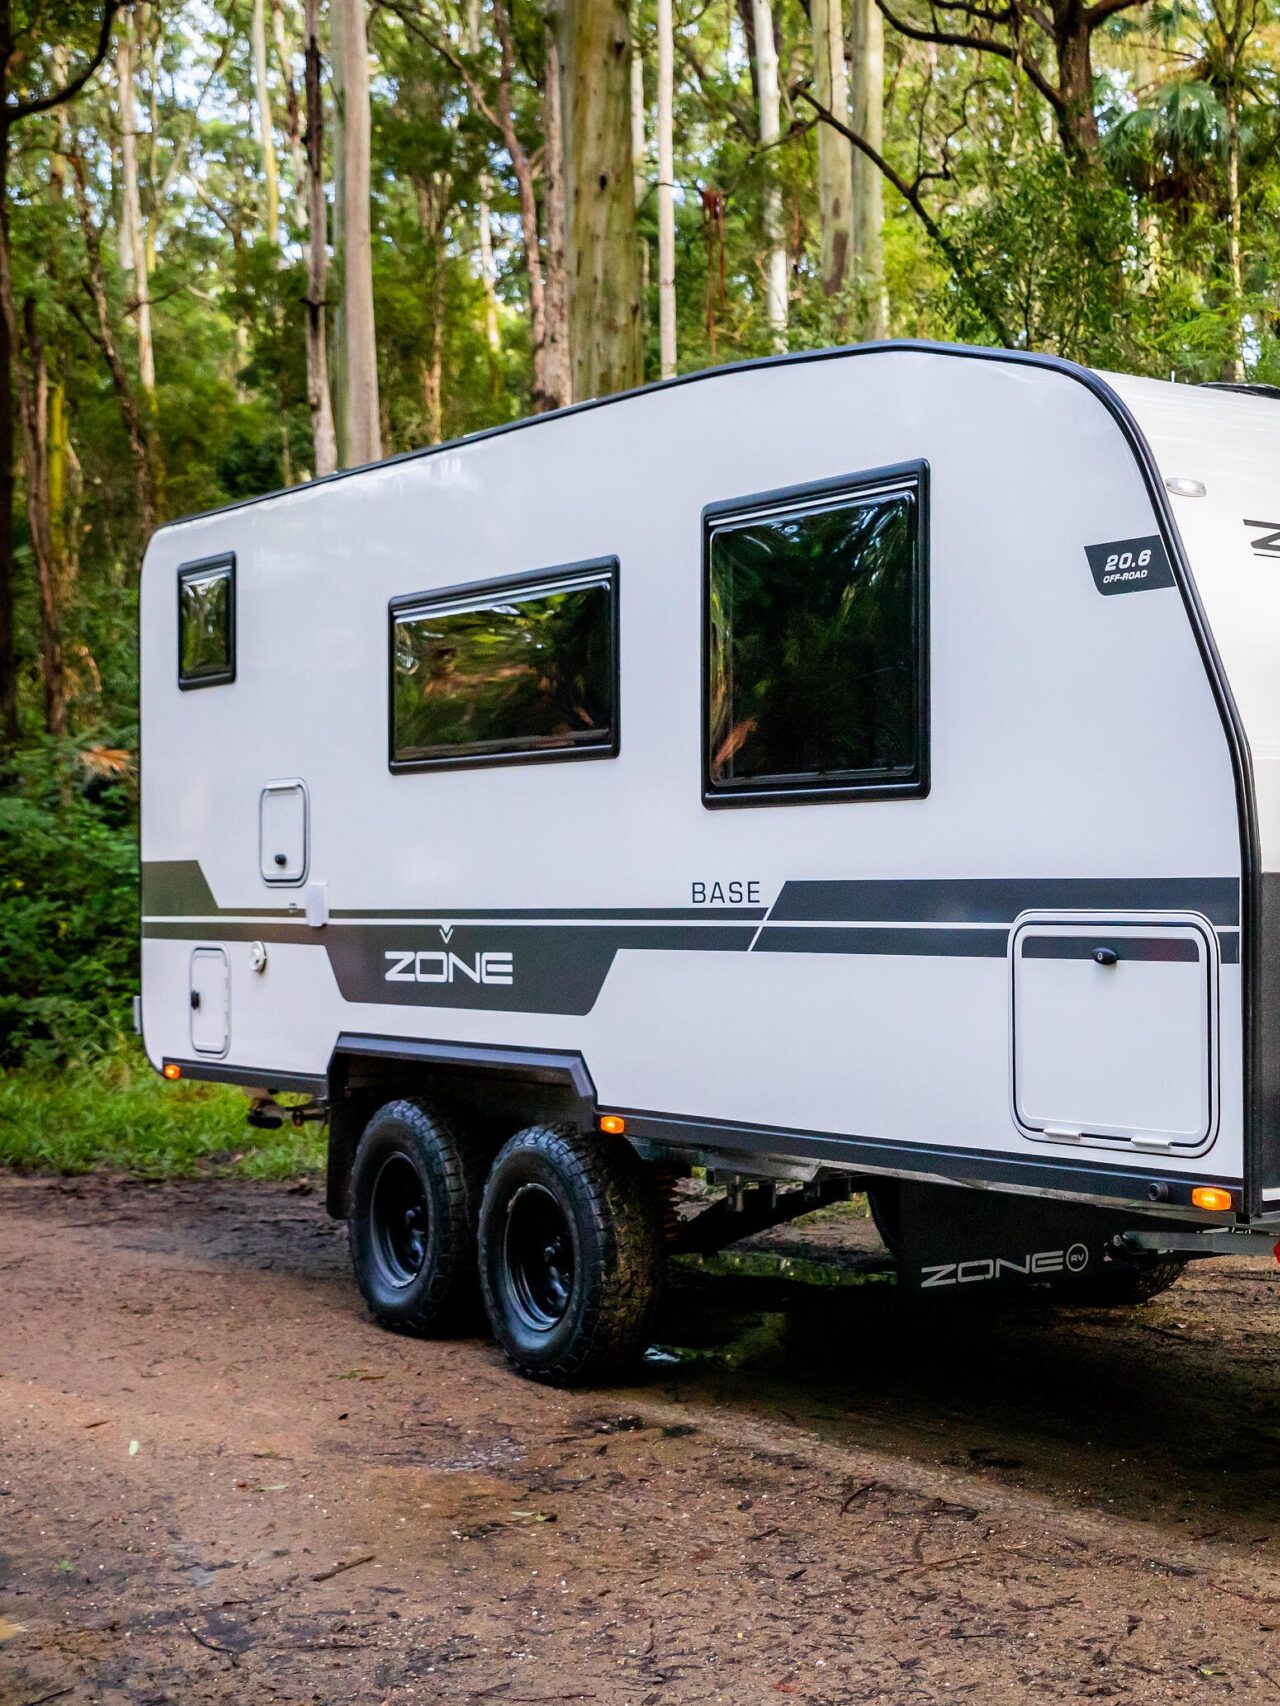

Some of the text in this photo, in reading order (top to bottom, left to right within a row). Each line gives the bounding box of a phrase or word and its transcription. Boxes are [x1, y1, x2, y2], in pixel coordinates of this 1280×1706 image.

[1104, 549, 1152, 572] 20.6
[1103, 569, 1148, 584] OFF-ROAD
[691, 881, 761, 904] BASE
[384, 951, 514, 985] ZONE
[920, 1250, 1064, 1288] ZONE
